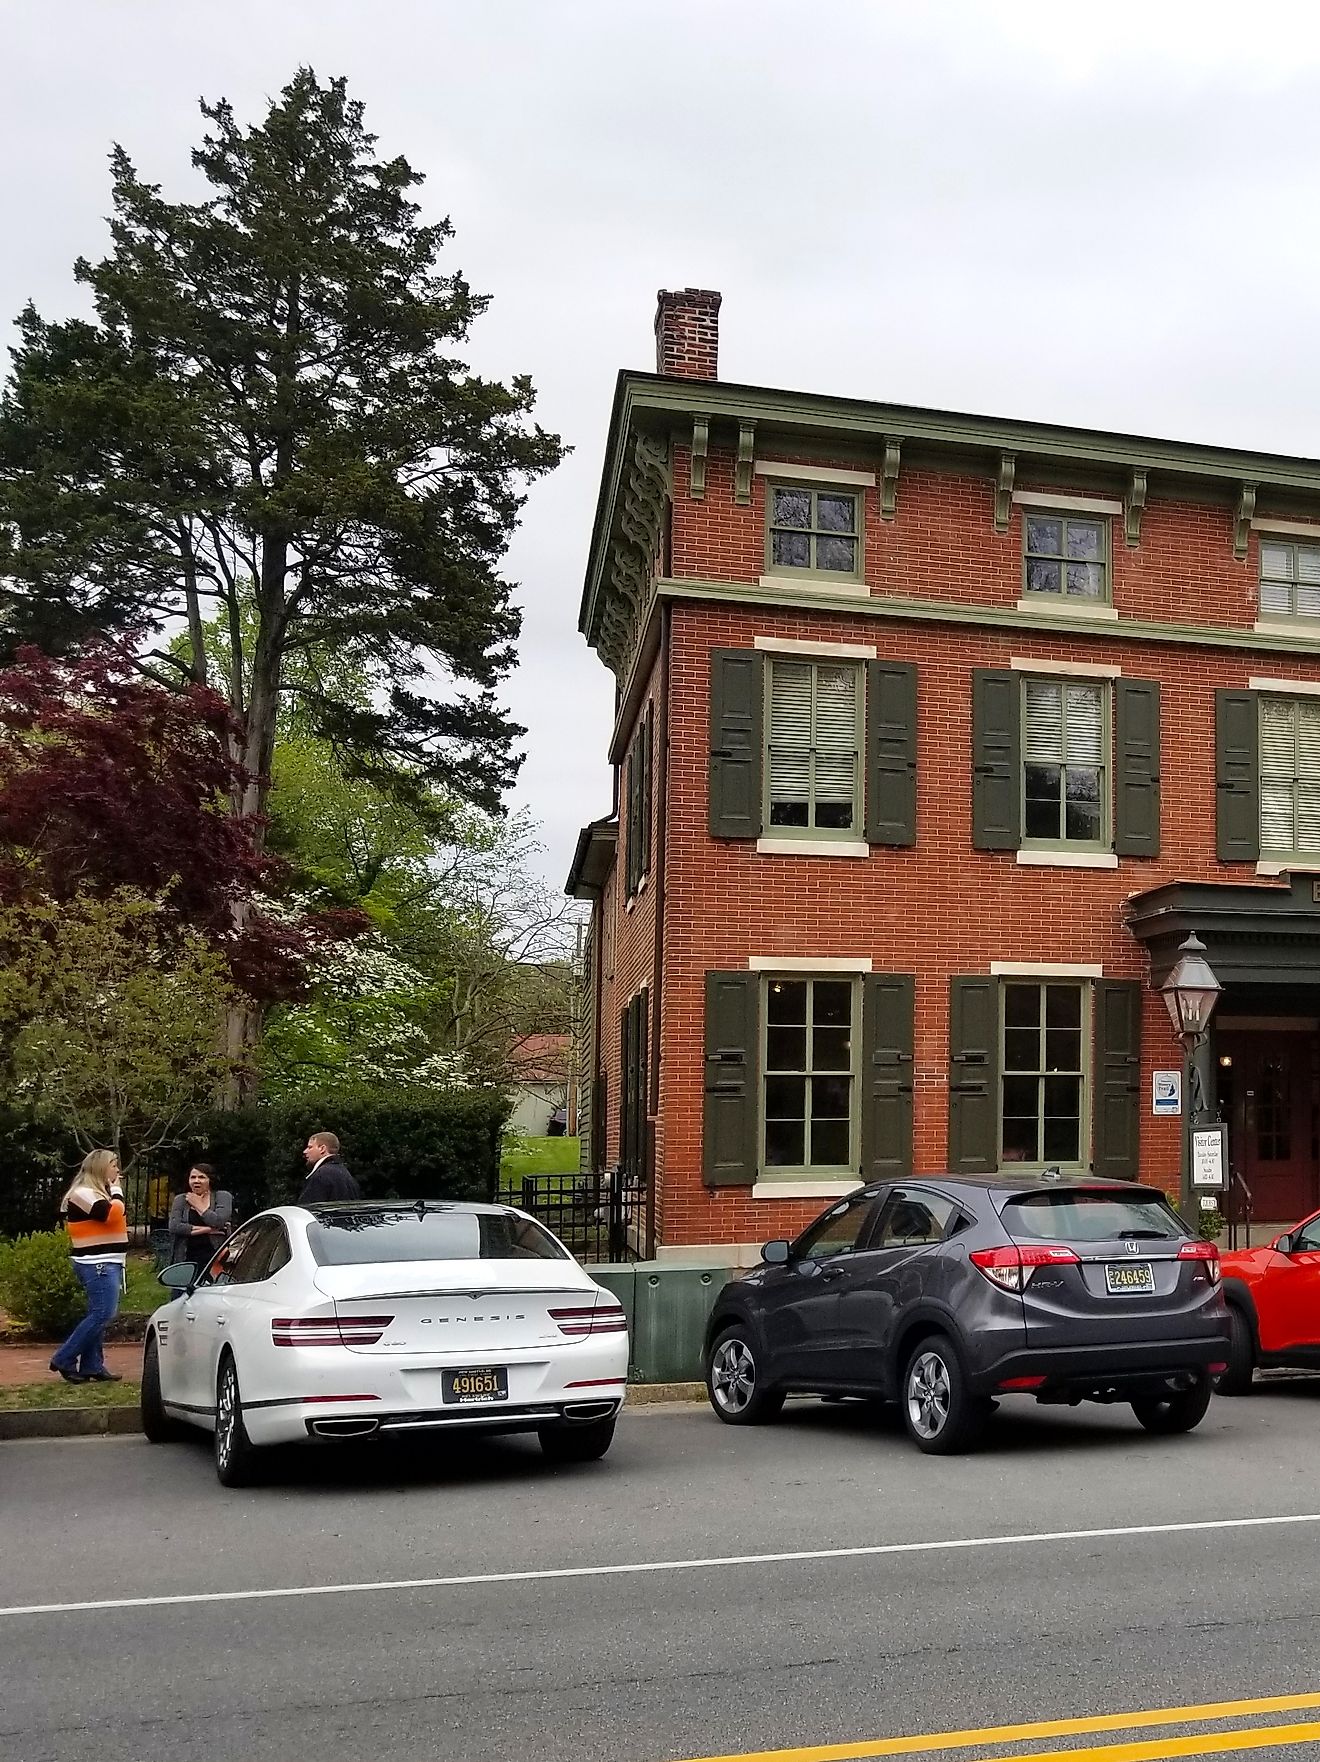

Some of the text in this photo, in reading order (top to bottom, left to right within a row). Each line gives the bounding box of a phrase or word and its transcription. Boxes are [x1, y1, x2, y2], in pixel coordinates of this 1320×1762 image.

[1195, 1135, 1207, 1147] Visitor
[1114, 1269, 1151, 1285] 246459
[420, 1314, 526, 1323] GENESIS
[452, 1375, 499, 1394] 491651
